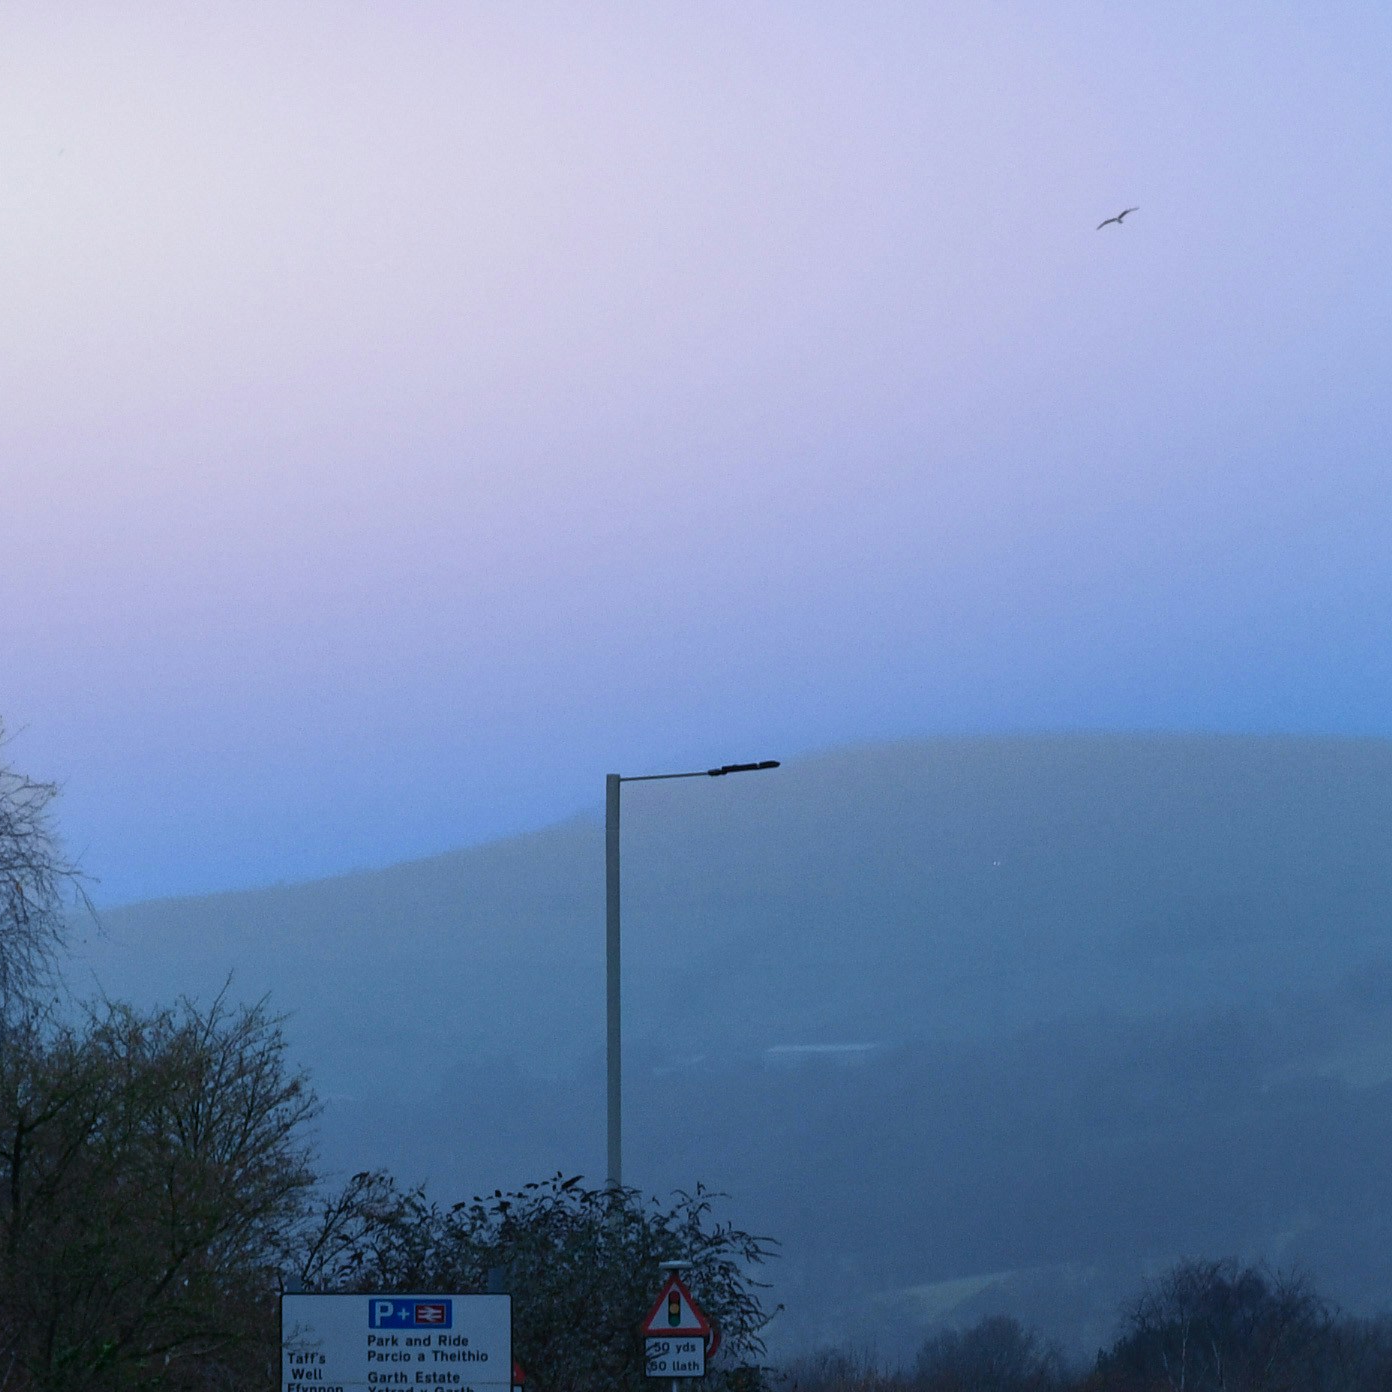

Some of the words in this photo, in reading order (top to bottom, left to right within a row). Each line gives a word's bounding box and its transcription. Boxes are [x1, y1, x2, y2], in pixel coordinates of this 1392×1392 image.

[375, 1301, 394, 1327] P
[367, 1335, 398, 1347] Park
[405, 1335, 431, 1347] and
[438, 1335, 469, 1347] Ride
[675, 1342, 696, 1353] yds
[288, 1352, 326, 1364] Taff's
[367, 1350, 411, 1361] Parcio
[432, 1350, 489, 1361] Theithio
[672, 1361, 700, 1371] llath
[291, 1369, 323, 1380] Well
[368, 1371, 408, 1383] Garth
[415, 1371, 460, 1383] Estate
